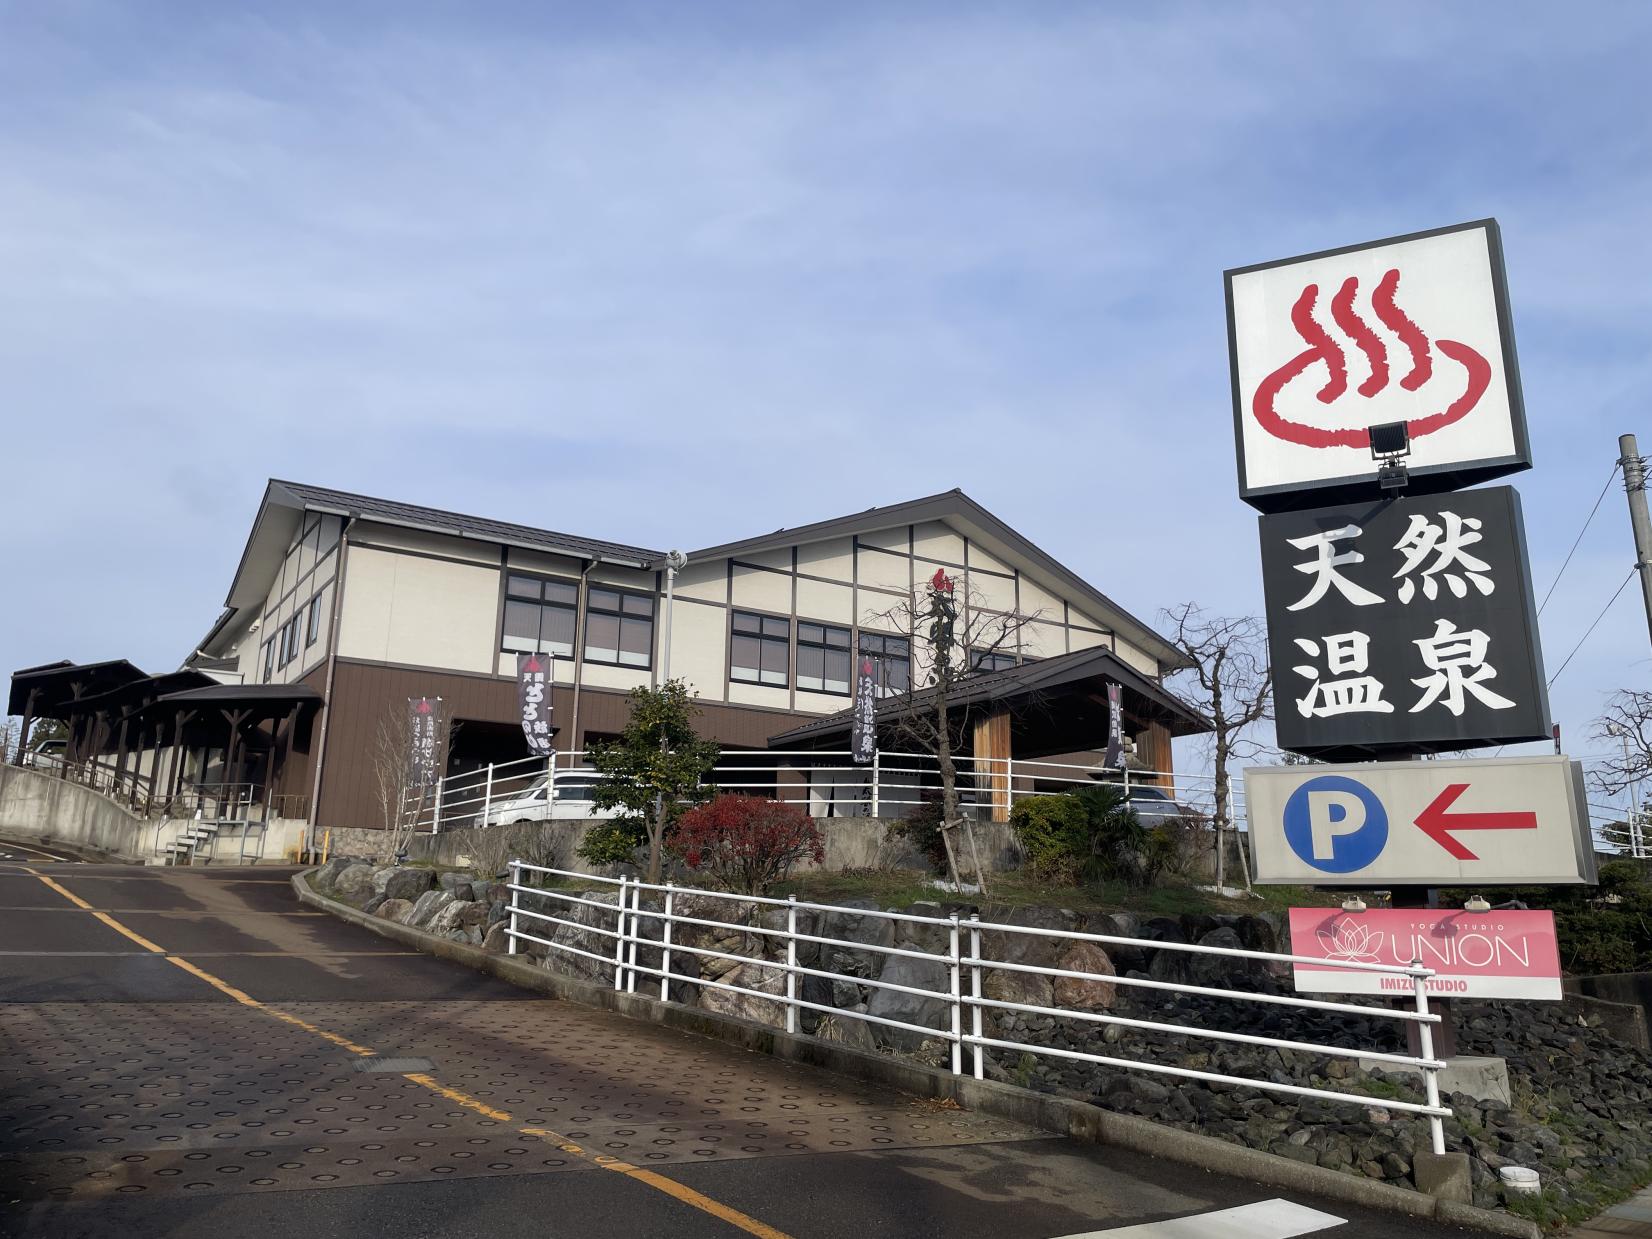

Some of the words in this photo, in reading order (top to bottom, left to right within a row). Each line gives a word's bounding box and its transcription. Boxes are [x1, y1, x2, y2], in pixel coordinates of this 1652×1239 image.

[1285, 511, 1496, 612] 天然
[1291, 618, 1517, 718] 温泉
[1307, 790, 1367, 860] P
[1391, 933, 1530, 967] UNION
[1410, 923, 1445, 931] YOGA
[1455, 923, 1505, 931] STUDIO
